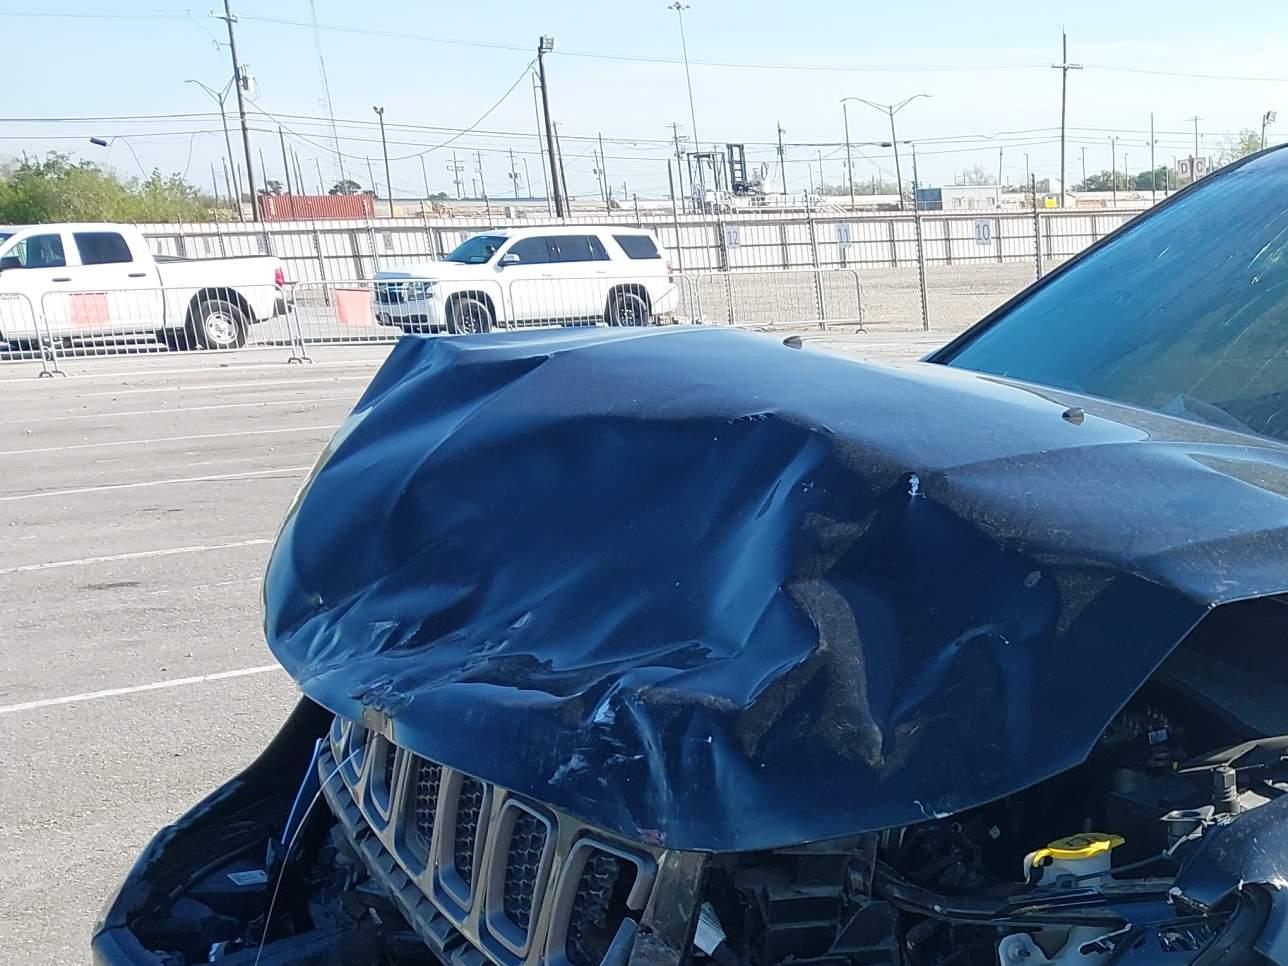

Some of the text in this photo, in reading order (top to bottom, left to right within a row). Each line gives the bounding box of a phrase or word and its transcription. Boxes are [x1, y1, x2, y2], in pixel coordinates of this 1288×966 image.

[1180, 162, 1188, 174] D
[1196, 161, 1204, 173] C
[727, 230, 739, 244] 12
[837, 228, 849, 243] 11
[976, 224, 990, 240] 10
